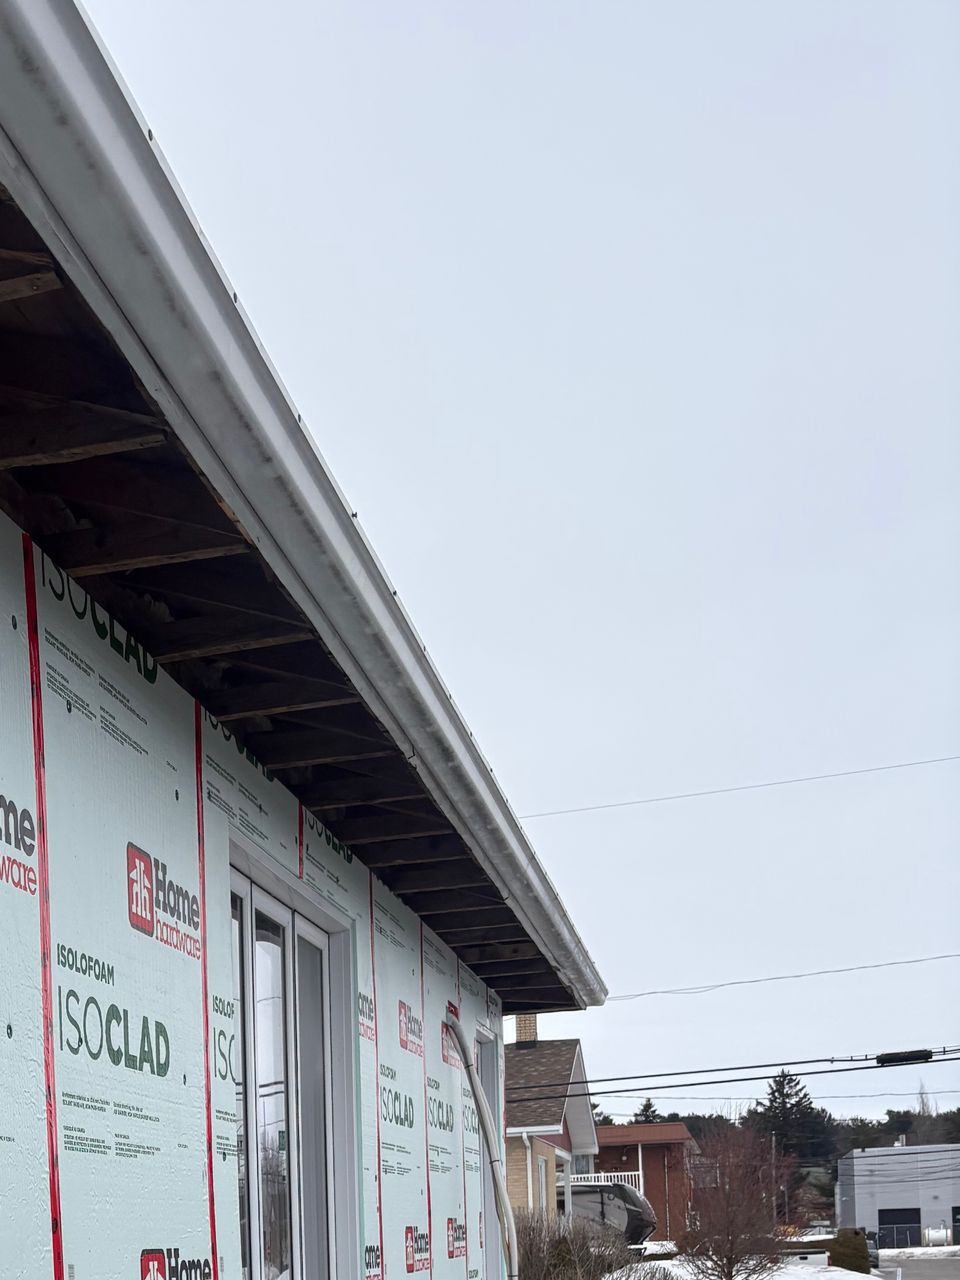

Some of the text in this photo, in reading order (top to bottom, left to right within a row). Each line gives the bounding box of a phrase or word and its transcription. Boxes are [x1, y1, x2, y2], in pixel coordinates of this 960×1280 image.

[153, 858, 201, 931] Home
[154, 909, 203, 960] hardware
[56, 943, 114, 987] ISOLOFOAM
[57, 986, 172, 1078] ISOCLAD
[379, 1085, 414, 1129] ISOCLAD
